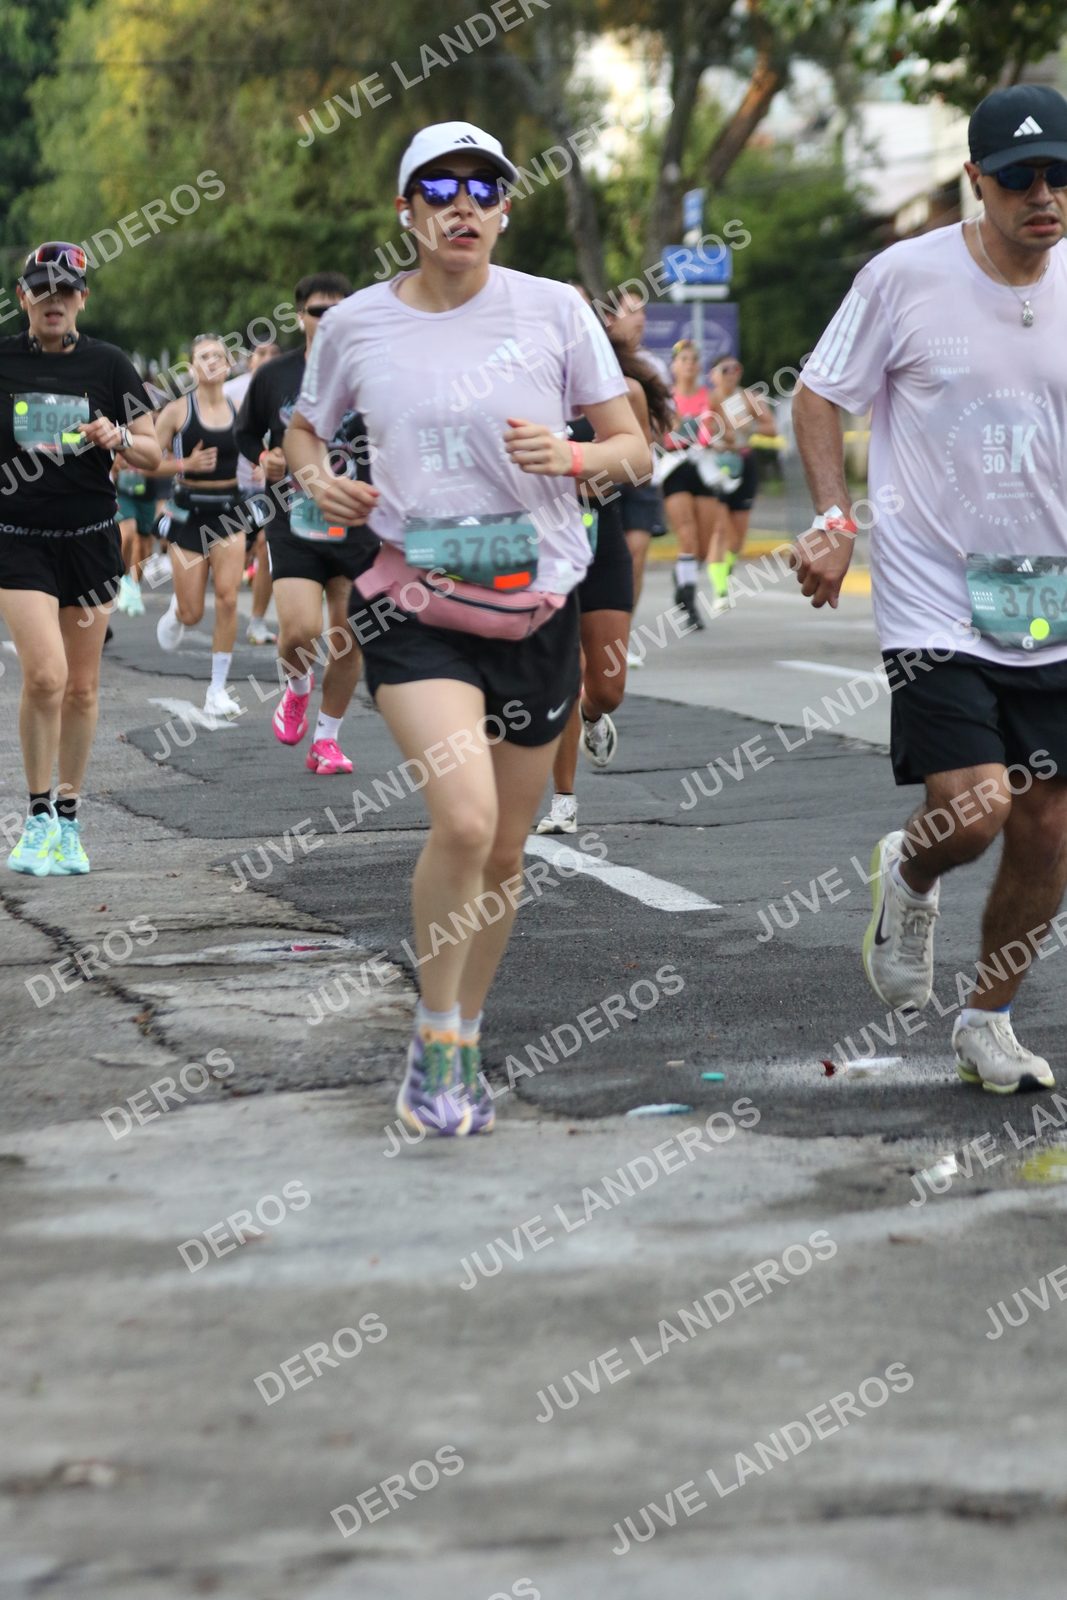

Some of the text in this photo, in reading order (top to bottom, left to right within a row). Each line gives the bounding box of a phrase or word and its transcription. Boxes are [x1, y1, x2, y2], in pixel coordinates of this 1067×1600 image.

[418, 428, 439, 447] 15
[982, 424, 1005, 445] 15
[444, 426, 475, 470] K
[1011, 424, 1038, 473] K
[421, 454, 442, 473] 30
[983, 454, 1005, 473] 30
[0, 518, 113, 537] OMPRESSPOR
[440, 534, 535, 573] 3763
[1022, 635, 1034, 649] G
